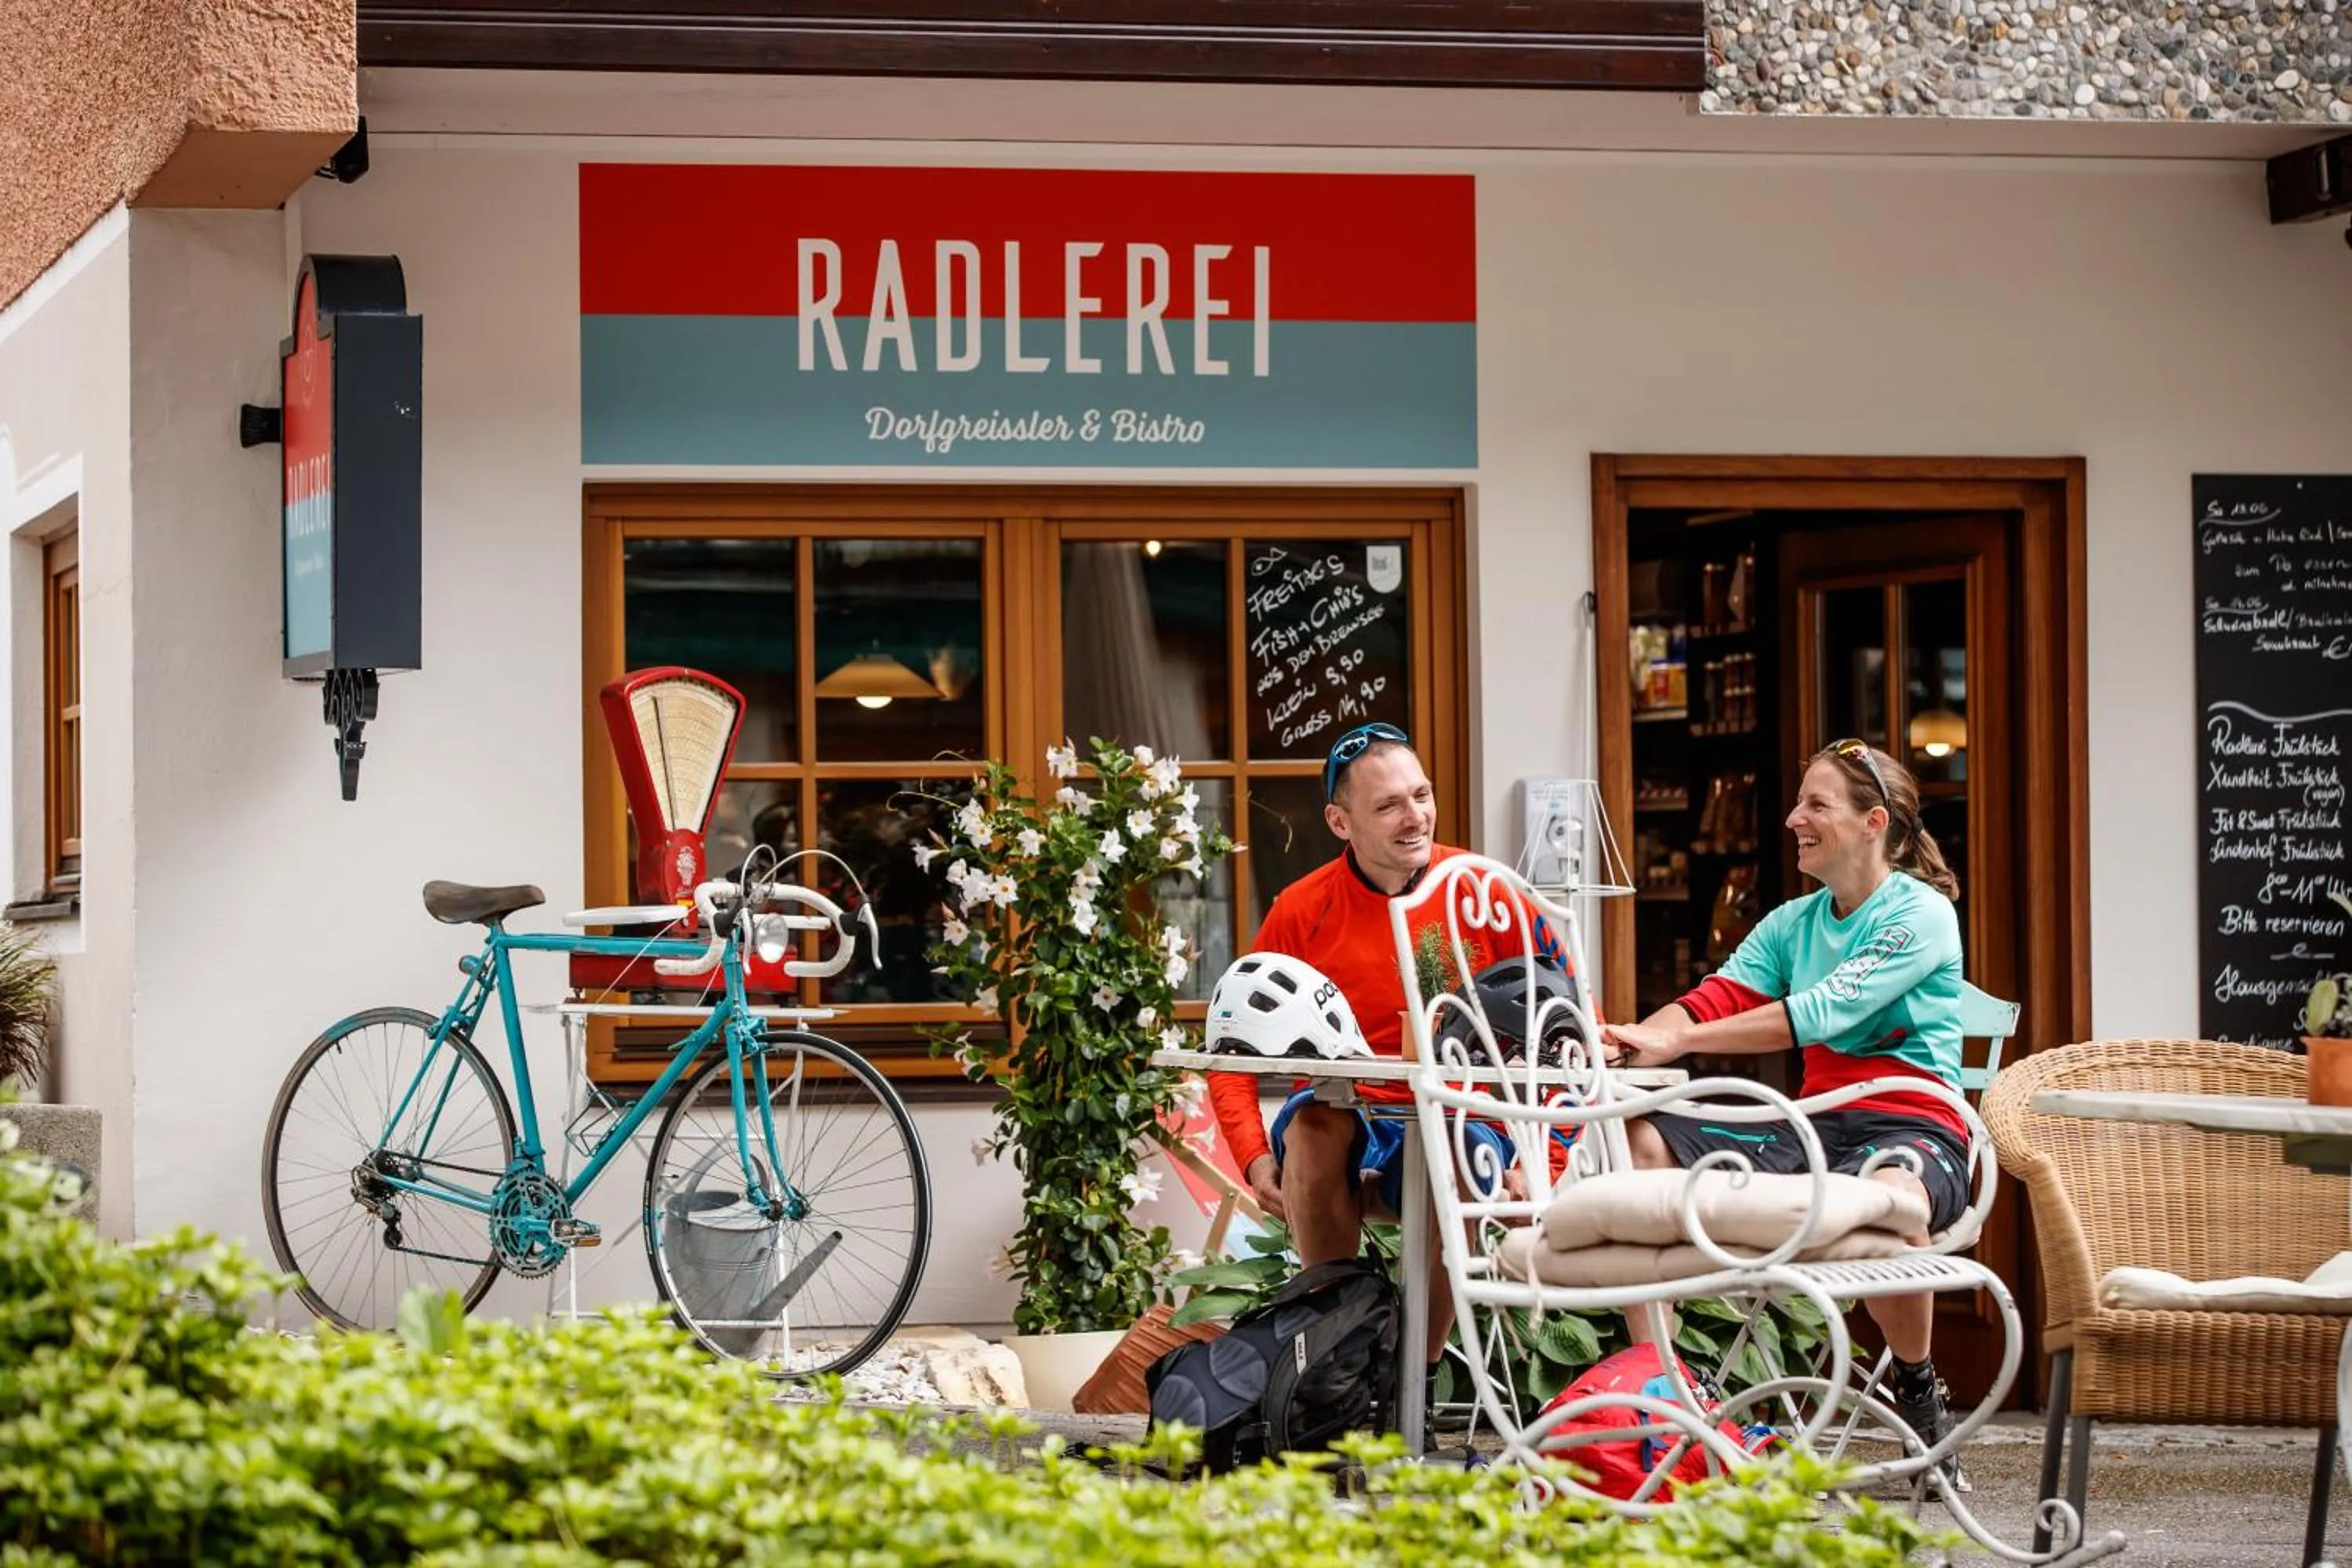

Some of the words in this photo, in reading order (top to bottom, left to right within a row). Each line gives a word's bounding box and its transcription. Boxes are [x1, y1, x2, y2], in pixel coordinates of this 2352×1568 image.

[797, 238, 1270, 377] RADLEREI
[865, 407, 1074, 453] Dorfgreissler
[1080, 408, 1102, 441] &
[1111, 408, 1205, 443] Bistro
[2217, 904, 2259, 936] Bitte
[2265, 915, 2344, 938] reservieren
